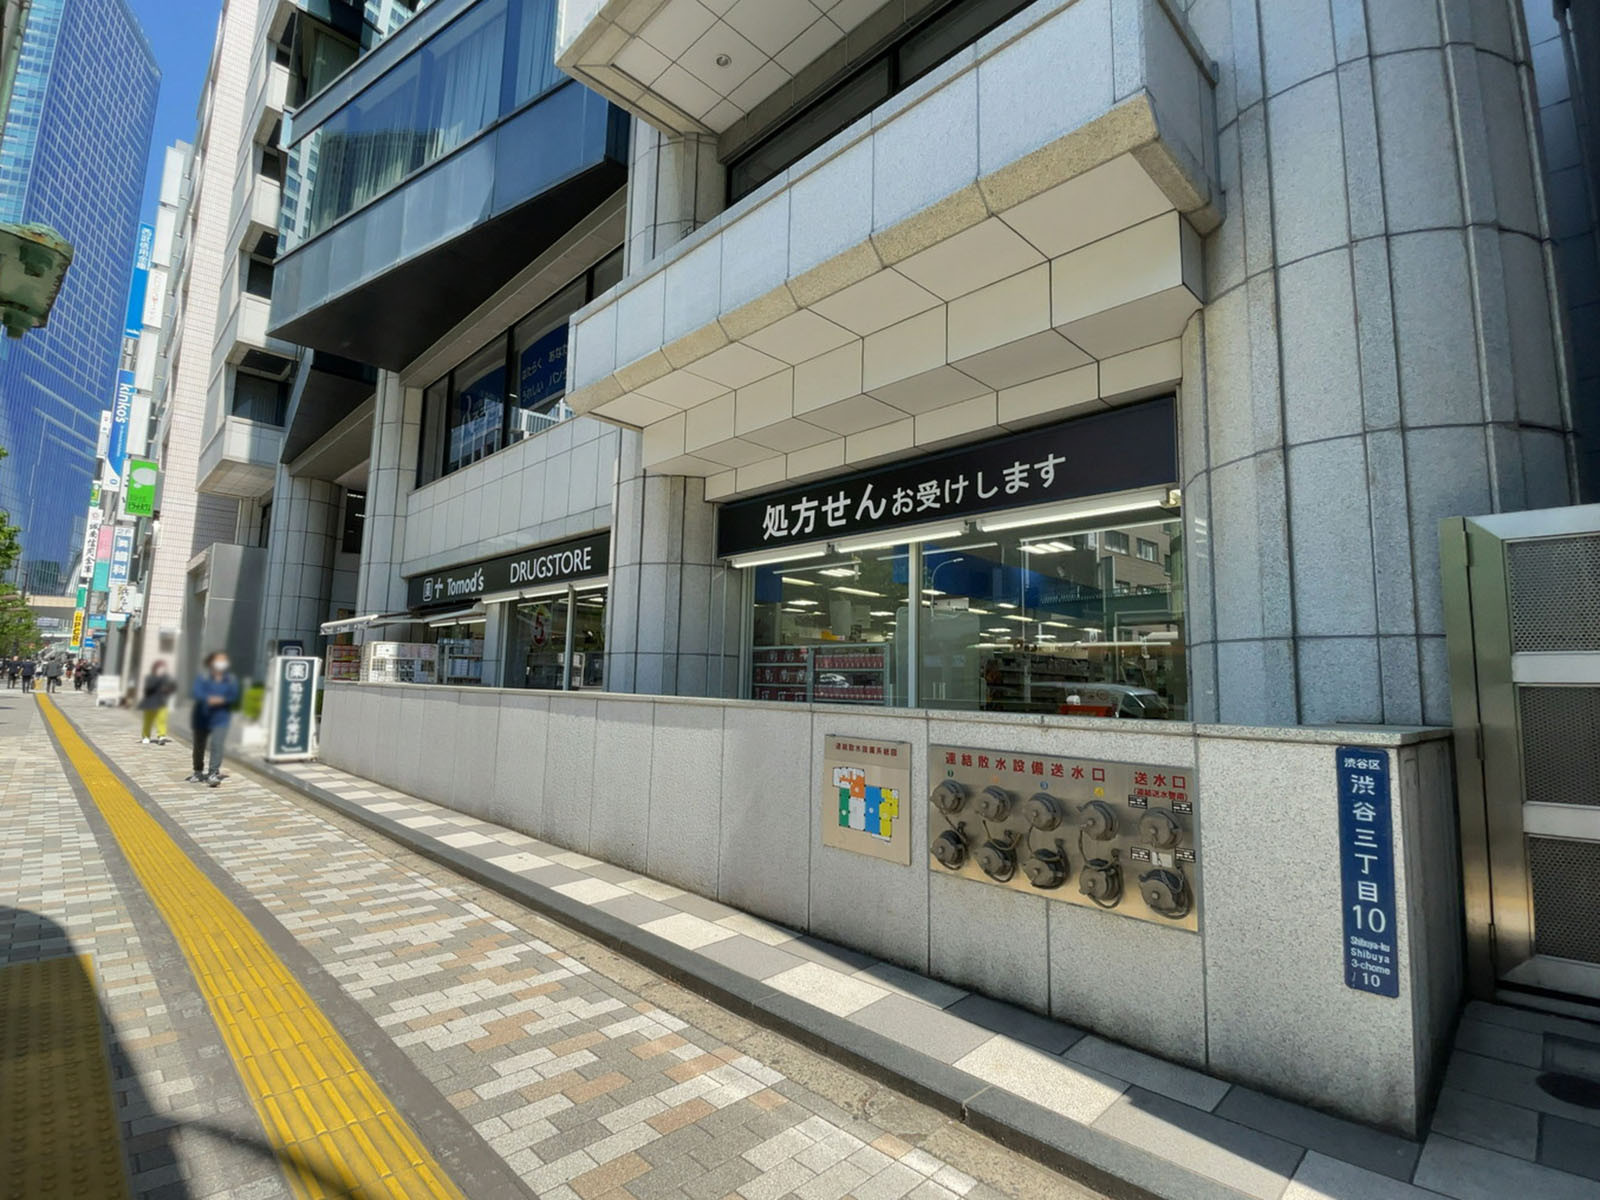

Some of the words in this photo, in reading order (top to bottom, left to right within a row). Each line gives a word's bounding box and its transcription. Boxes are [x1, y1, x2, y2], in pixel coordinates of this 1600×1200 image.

[115, 383, 134, 424] kinko's
[510, 546, 592, 584] DRUGSTORE
[447, 567, 485, 596] Tomod's
[945, 751, 1106, 782] 連結散水設備送水口
[1343, 757, 1381, 770] 渋谷区
[1134, 771, 1187, 789] 送水口
[1351, 774, 1379, 903] 渋谷三丁目
[1352, 904, 1386, 934] 10
[1350, 935, 1391, 953] Shibuya-ku
[1350, 947, 1390, 965] Shibuya
[1351, 958, 1391, 976] 3-chome
[1362, 972, 1381, 988] 10
